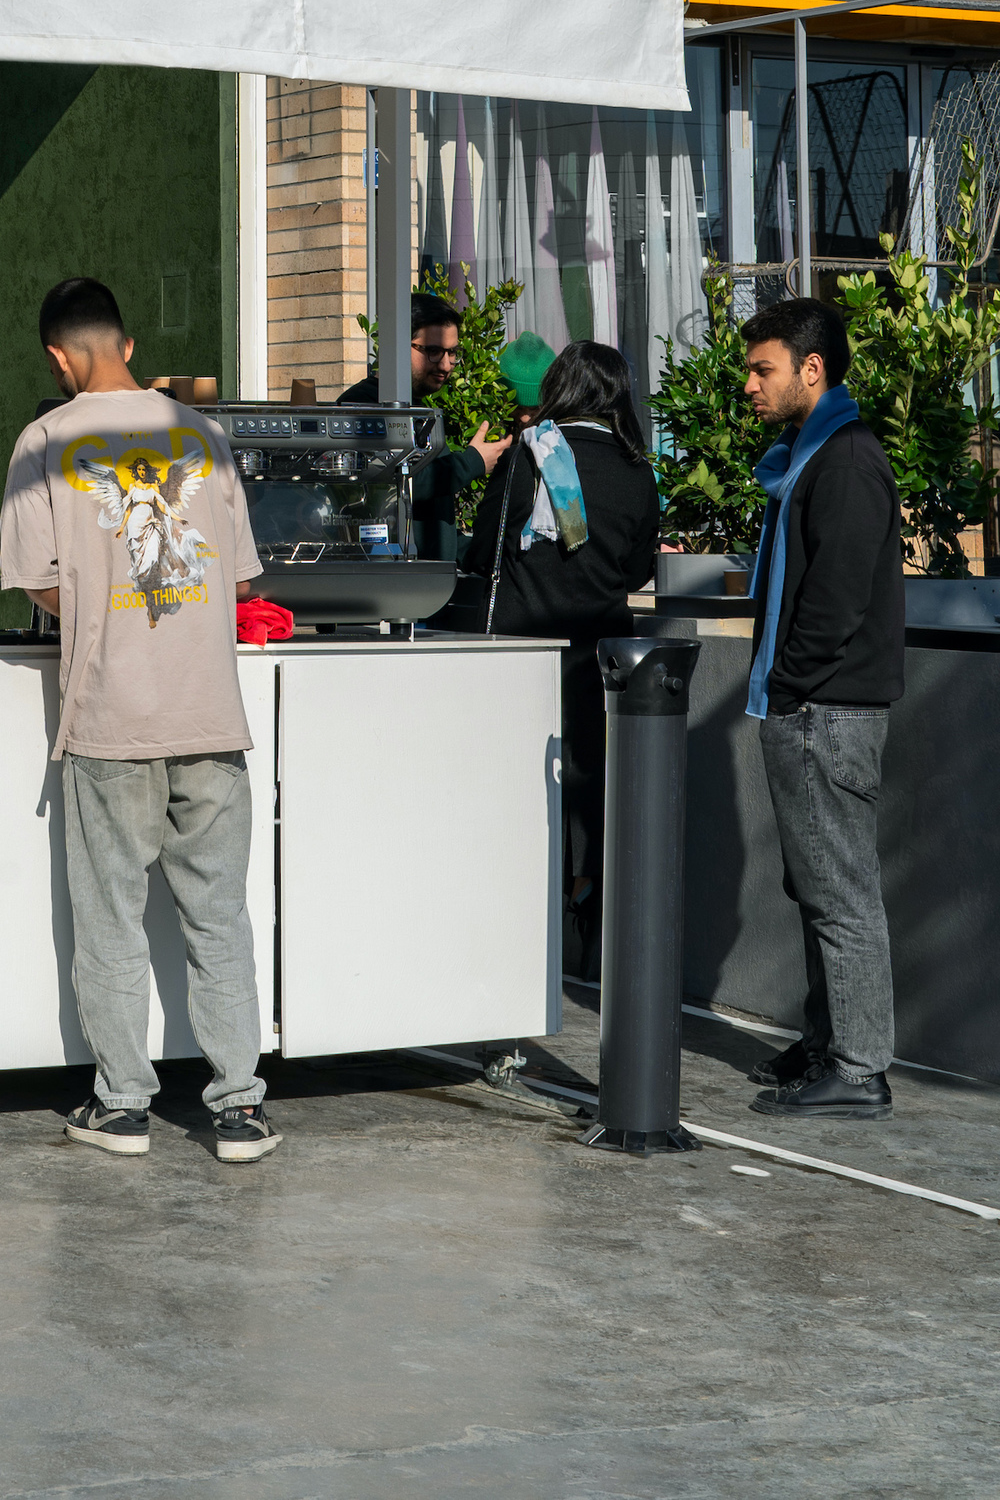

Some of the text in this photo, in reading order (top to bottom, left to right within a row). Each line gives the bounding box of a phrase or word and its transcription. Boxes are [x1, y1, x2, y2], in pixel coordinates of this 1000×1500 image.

[121, 430, 153, 441] WITH
[60, 427, 214, 493] GOD
[224, 1110, 240, 1120] NIKE
